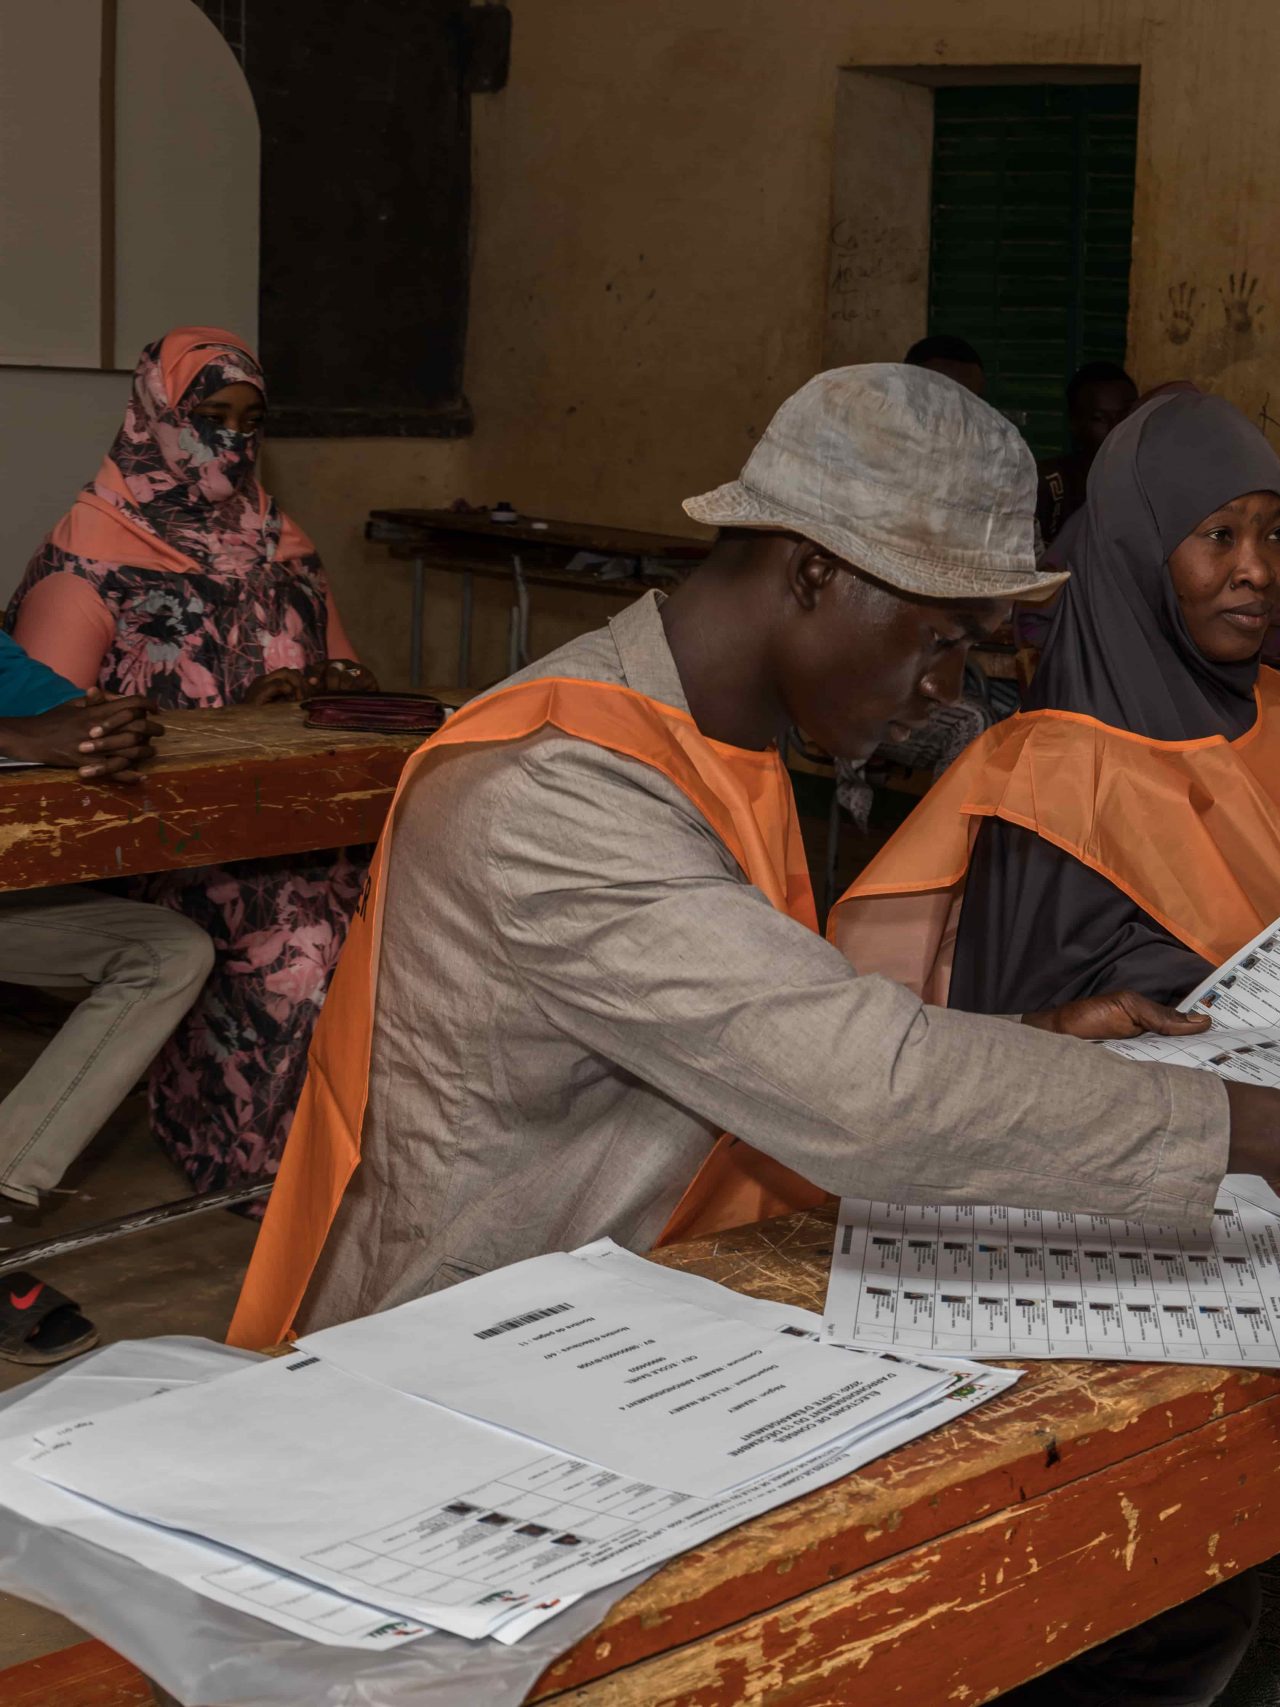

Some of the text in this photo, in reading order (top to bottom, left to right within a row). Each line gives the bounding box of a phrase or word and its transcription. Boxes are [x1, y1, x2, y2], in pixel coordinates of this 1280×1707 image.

[695, 1365, 724, 1379] NIAMEY
[709, 1386, 731, 1396] VILLE
[807, 1372, 896, 1417] D'ARRONDISSEMENT
[812, 1391, 838, 1406] LISTE
[668, 1399, 698, 1414] NIAMEY
[727, 1397, 757, 1413] NIAMEY
[828, 1389, 880, 1418] ÉLECTIONS
[739, 1404, 813, 1441] D'ÉMARGEMENT
[779, 1423, 793, 1431] 13
[791, 1415, 809, 1426] DU
[814, 1414, 830, 1425] DE
[773, 1422, 817, 1444] CONSEIL
[726, 1428, 783, 1458] DÉCEMBRE
